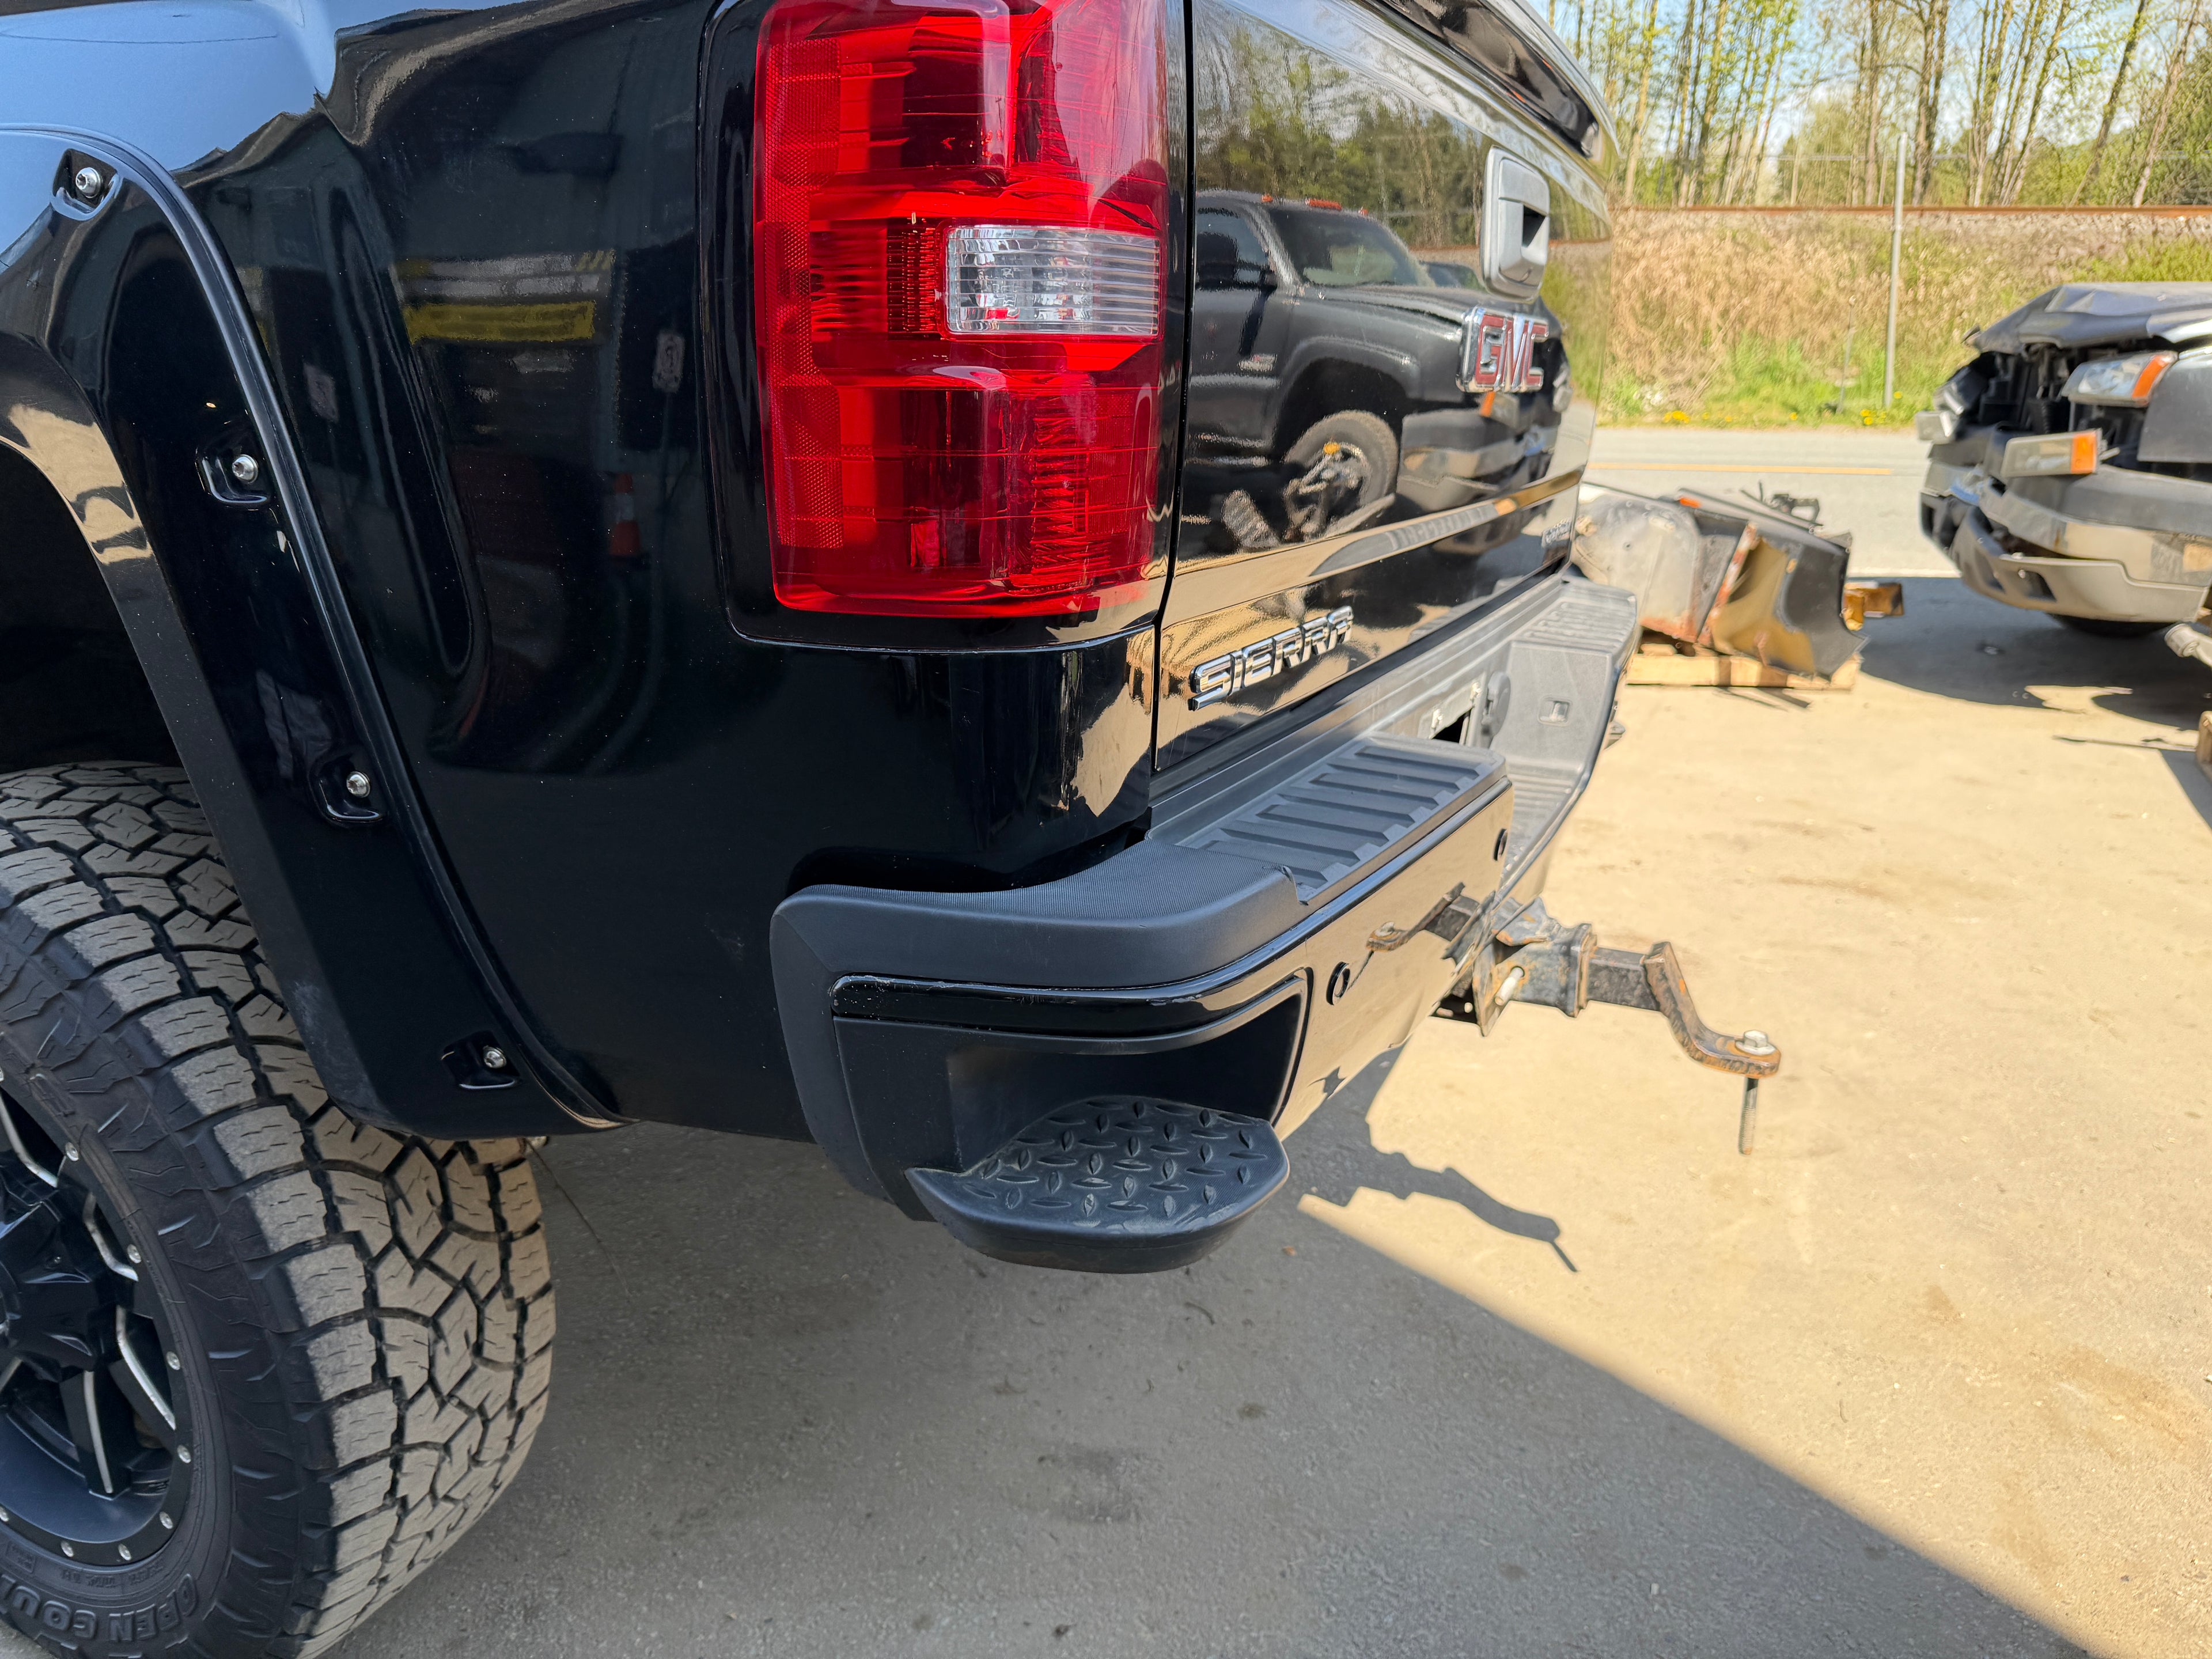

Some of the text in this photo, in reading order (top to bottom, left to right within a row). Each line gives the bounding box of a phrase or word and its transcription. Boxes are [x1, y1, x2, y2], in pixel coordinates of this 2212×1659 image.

[1466, 308, 1550, 393] GMC
[1187, 605, 1354, 711] SIERRA
[109, 1573, 198, 1641] OPEN
